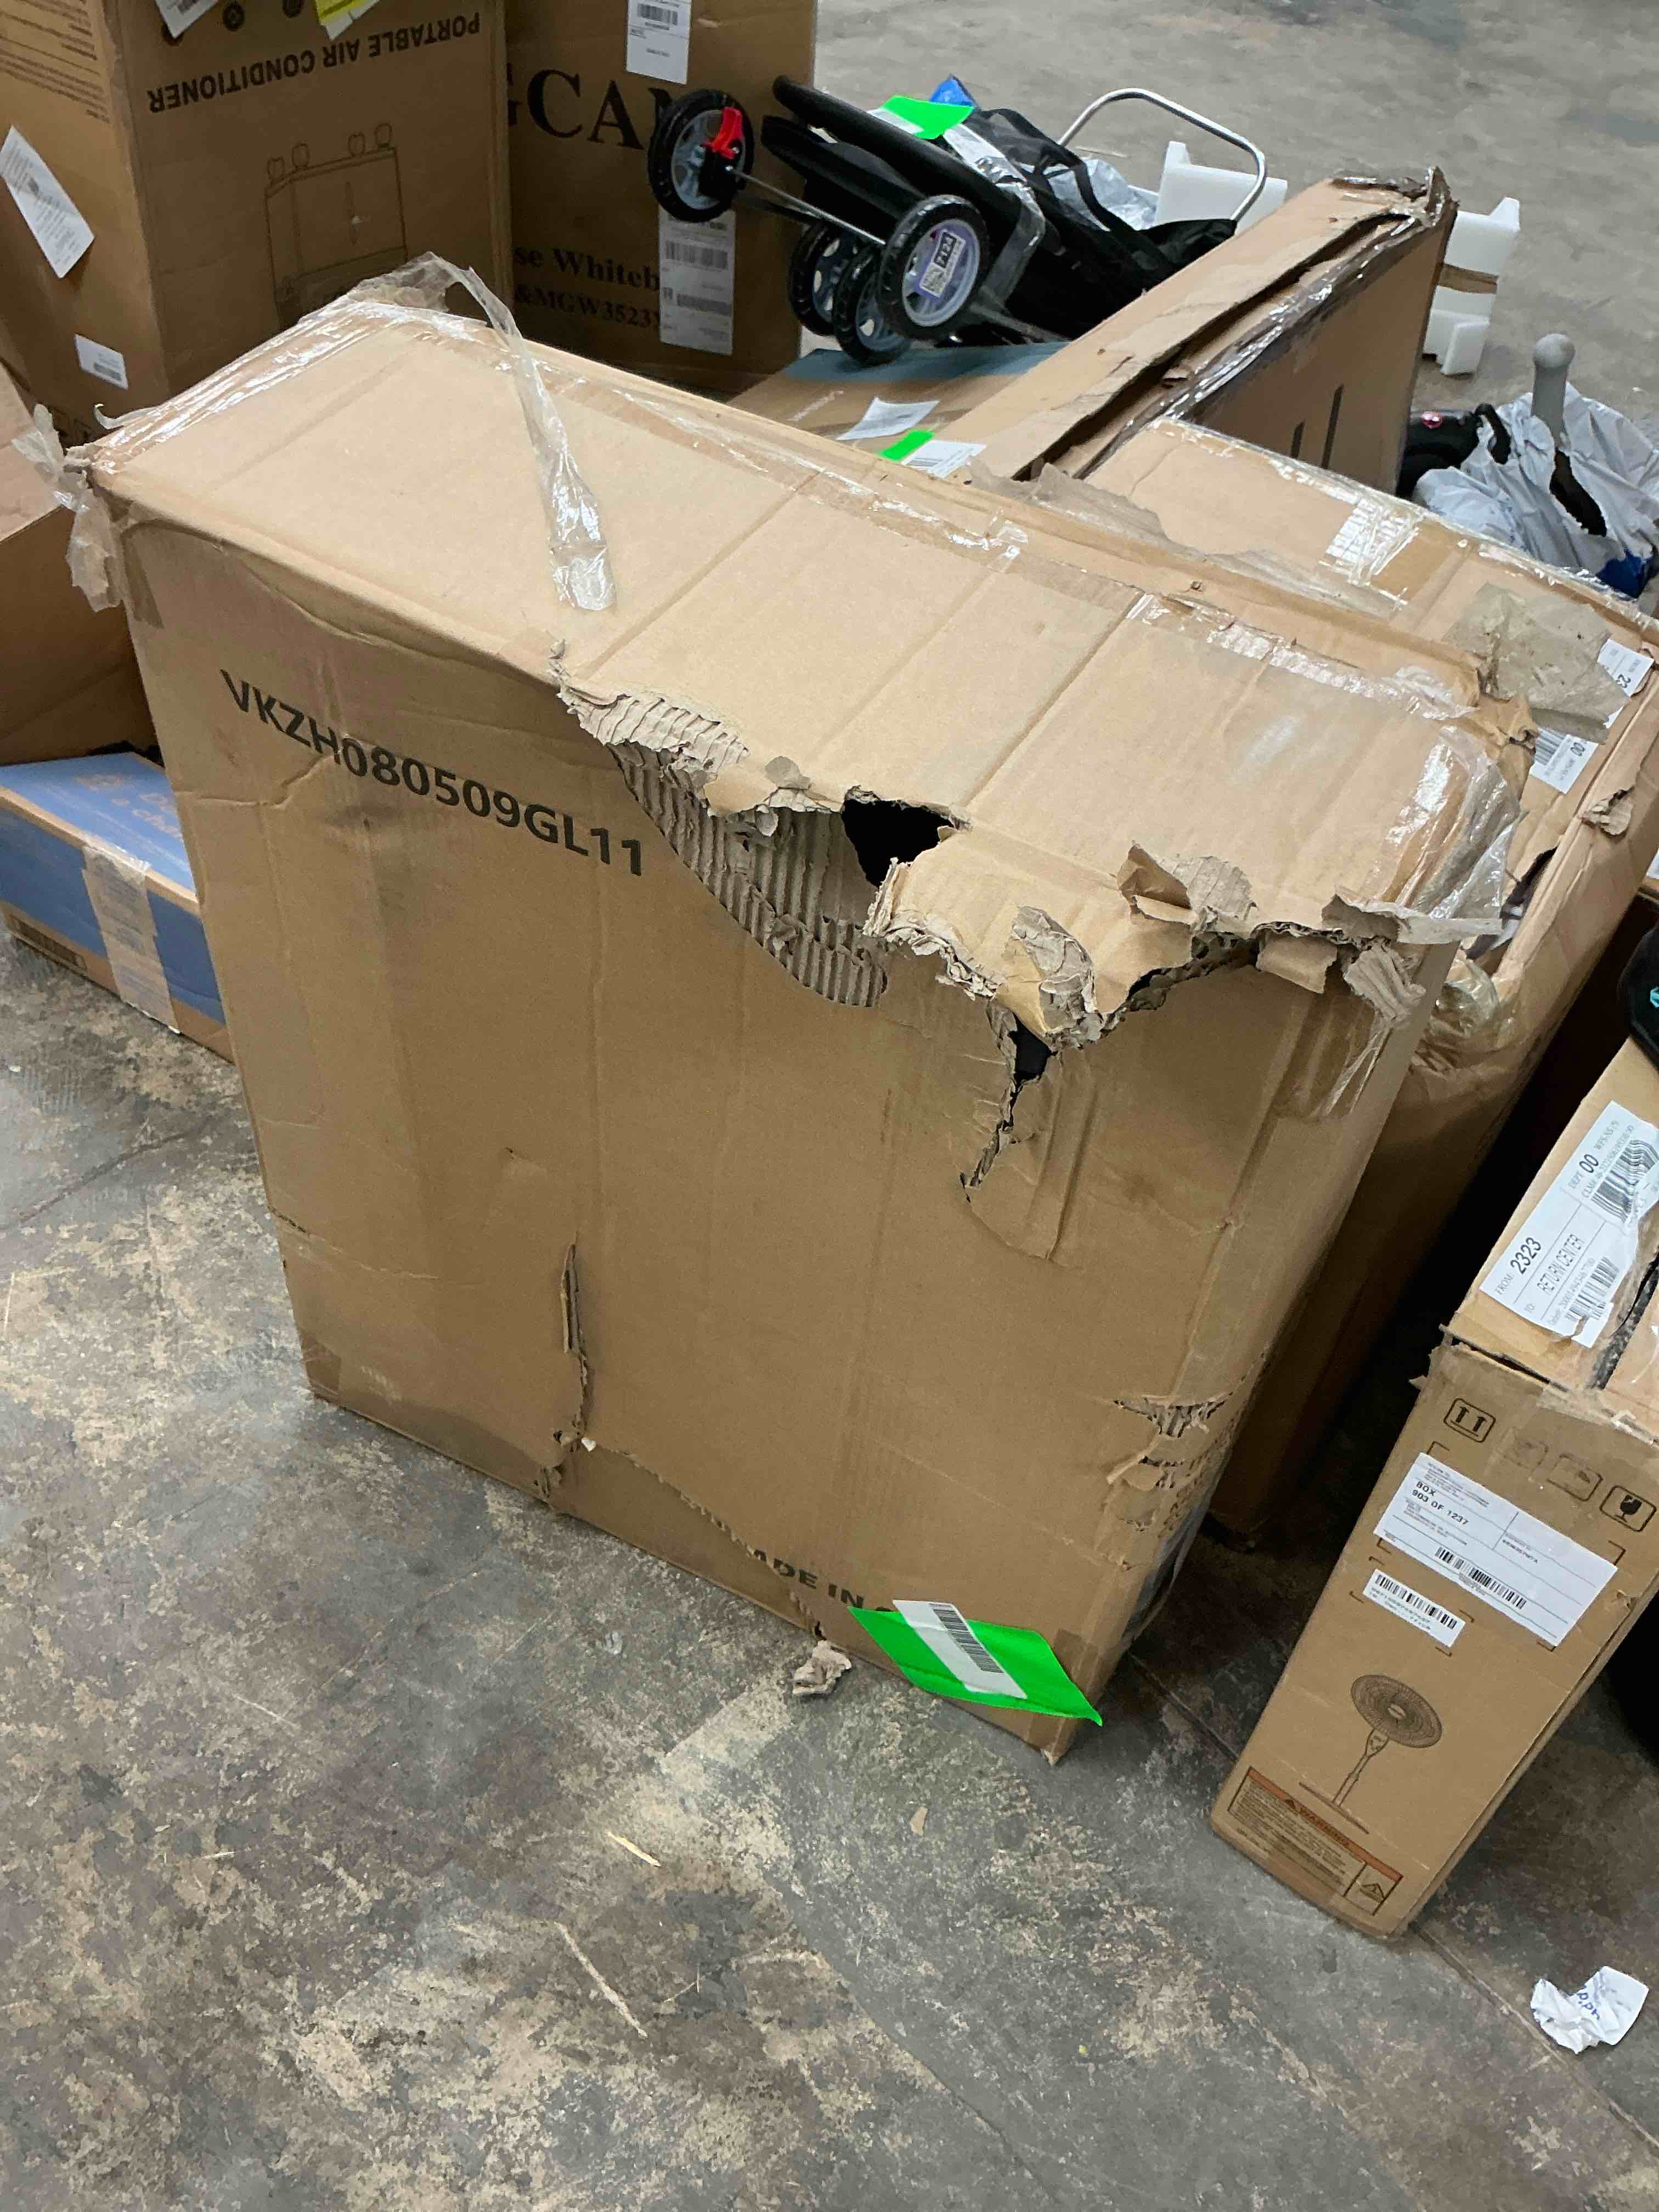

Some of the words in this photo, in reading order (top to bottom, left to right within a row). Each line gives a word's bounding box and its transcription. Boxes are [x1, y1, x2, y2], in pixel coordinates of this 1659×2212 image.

[368, 12, 480, 58] PORTABLE
[323, 39, 360, 69] AIR
[147, 50, 315, 114] CONDITIONER
[507, 62, 672, 149] CA
[220, 669, 642, 877] VKZH080509GL11
[1578, 1154, 1599, 1173] 00
[1510, 1237, 1542, 1274] 2323
[1537, 1261, 1565, 1294] RETURN
[1556, 1234, 1584, 1266] CENTER
[1412, 1489, 1429, 1502] 903
[1431, 1500, 1444, 1510] OF
[1448, 1510, 1469, 1525] 1237
[1416, 1481, 1436, 1497] BOX
[827, 1582, 865, 1609] IN
